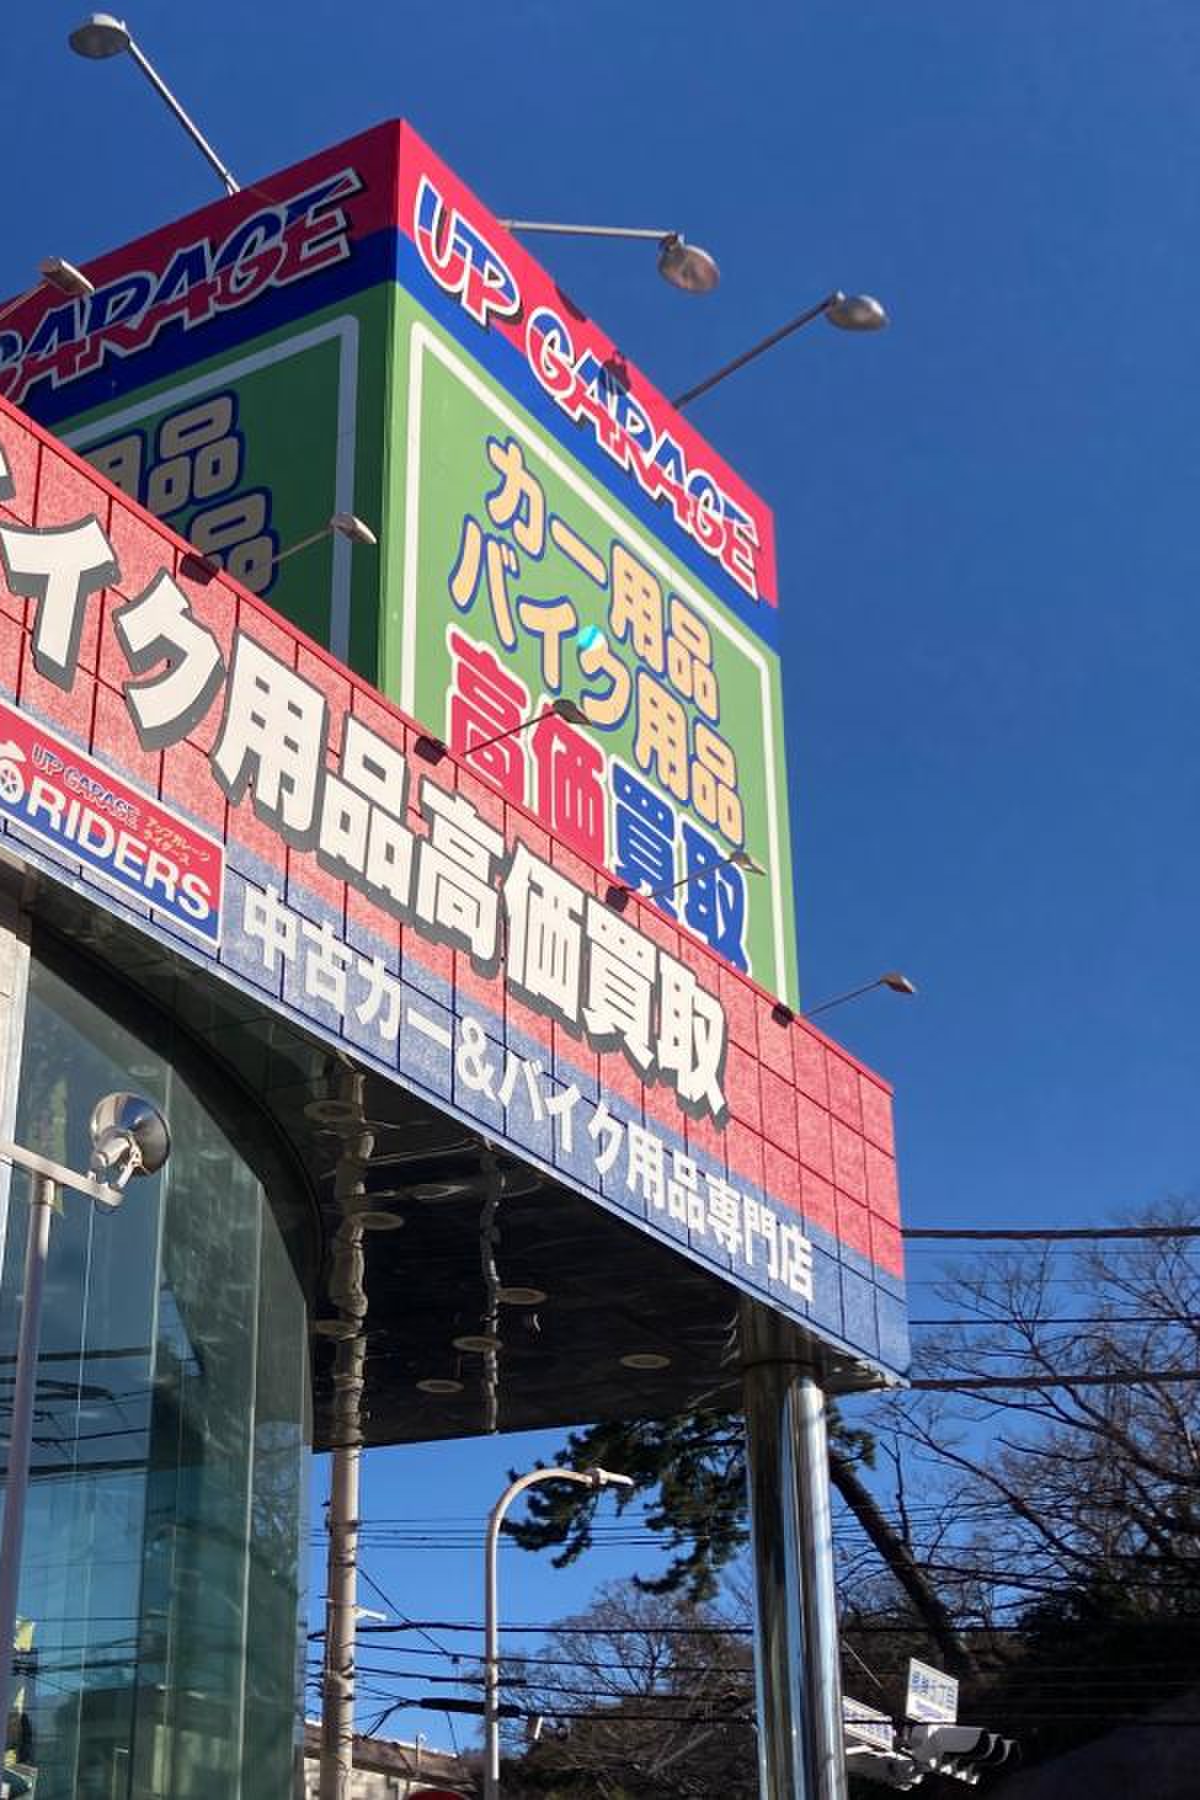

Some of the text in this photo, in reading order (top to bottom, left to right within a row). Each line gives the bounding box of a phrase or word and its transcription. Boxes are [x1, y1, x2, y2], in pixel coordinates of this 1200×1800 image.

[413, 174, 761, 599] UP GARAGE
[448, 515, 745, 850] バイク用品
[486, 436, 719, 722] カー用品
[26, 775, 212, 920] RIDERS
[446, 624, 751, 976] 高価買取
[242, 882, 814, 1303] 中古カー&バイク用品専門店
